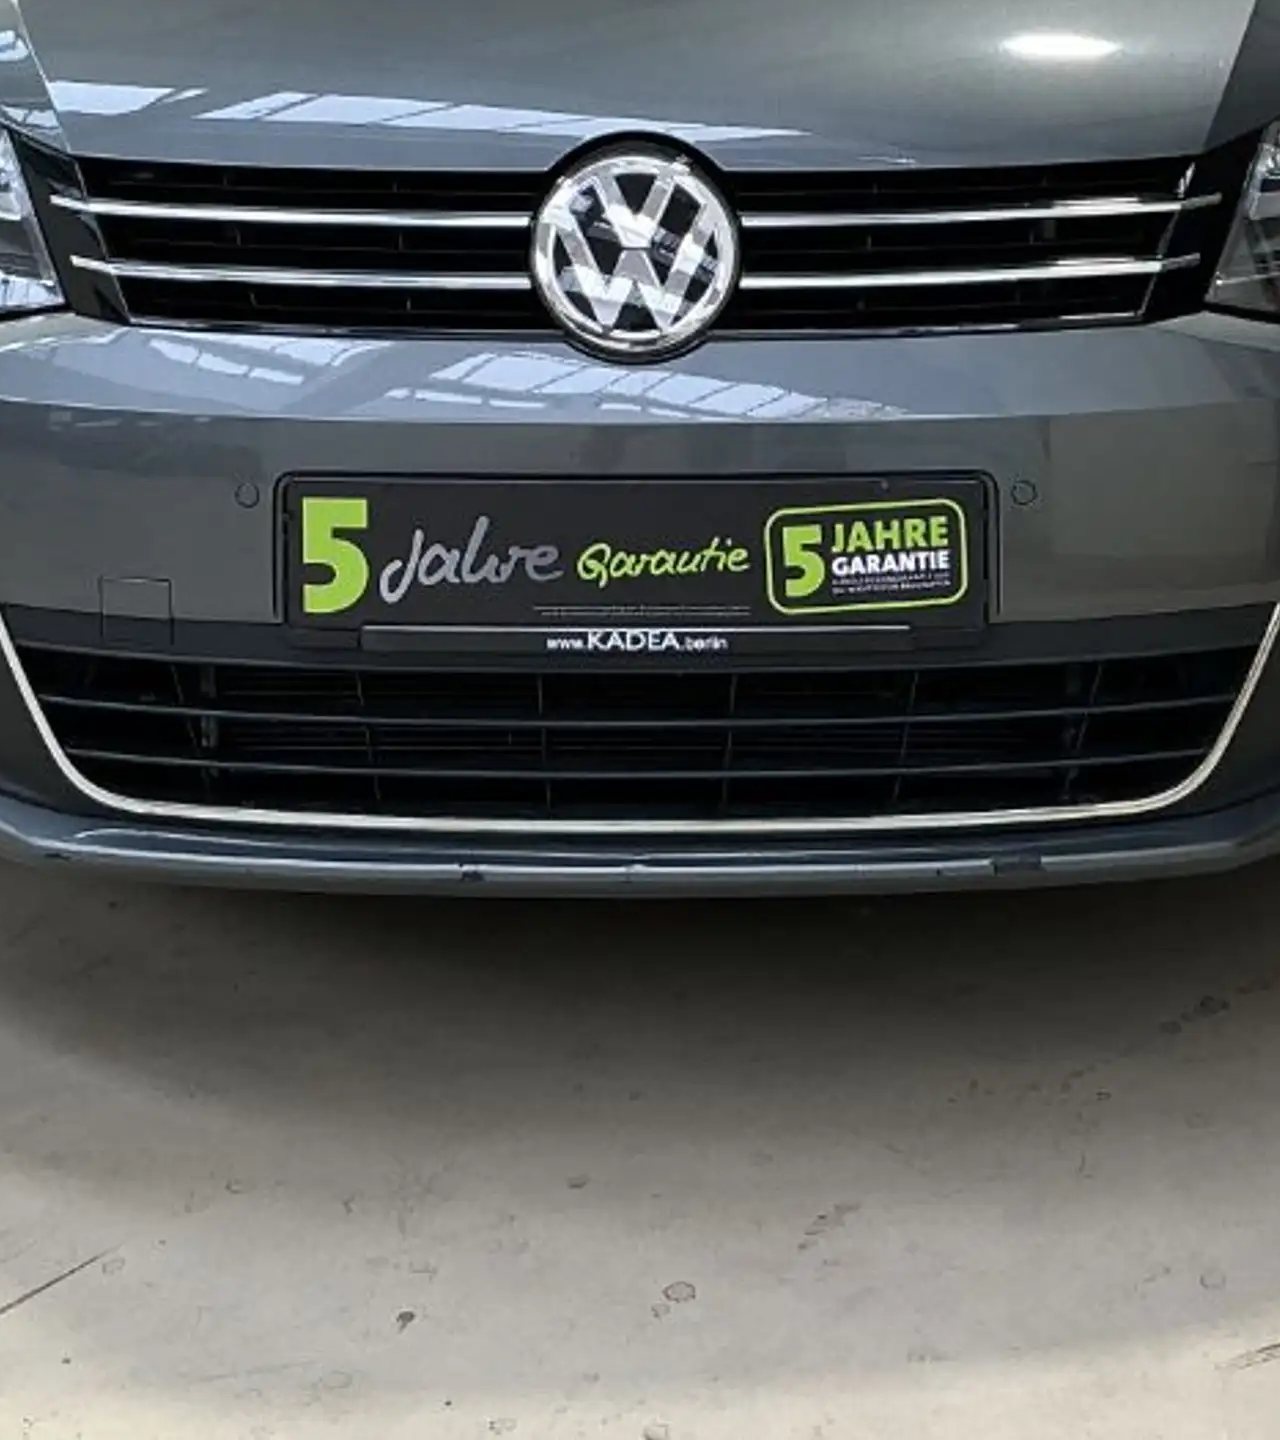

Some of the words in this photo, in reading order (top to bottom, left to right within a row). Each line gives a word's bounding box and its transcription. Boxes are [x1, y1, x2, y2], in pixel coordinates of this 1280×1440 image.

[301, 496, 369, 614] 5
[379, 515, 564, 604] Jahre
[576, 536, 751, 589] Garantie
[782, 523, 826, 598] 5
[830, 515, 950, 554] JAHRE
[830, 549, 951, 577] GARANTIE
[546, 629, 729, 653] www.KADEA.berlin
